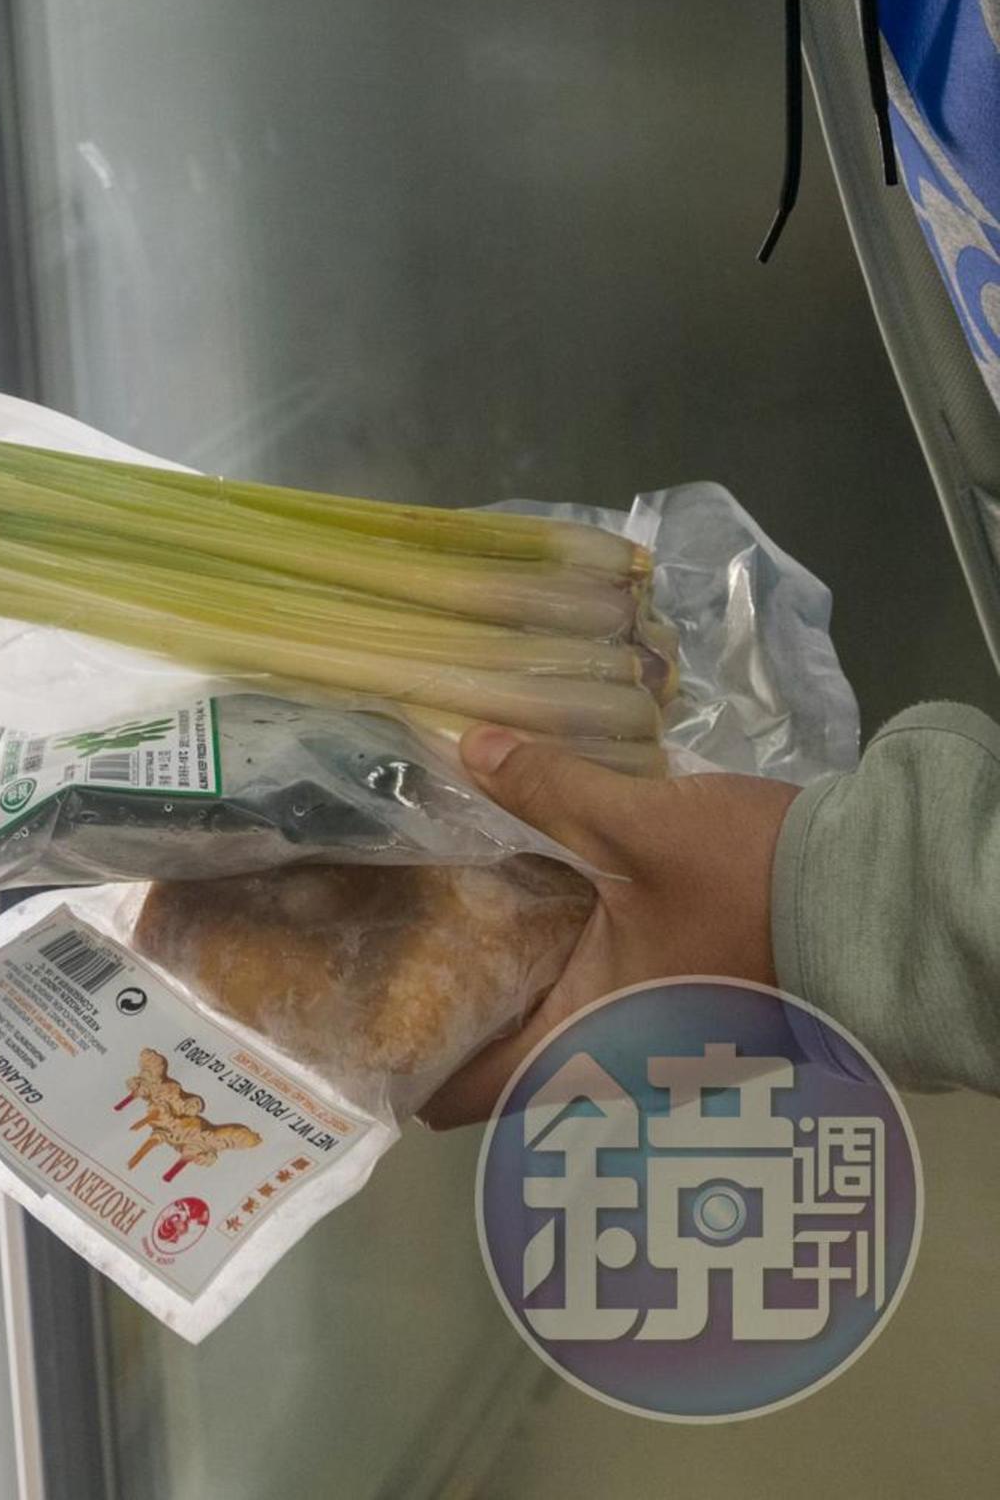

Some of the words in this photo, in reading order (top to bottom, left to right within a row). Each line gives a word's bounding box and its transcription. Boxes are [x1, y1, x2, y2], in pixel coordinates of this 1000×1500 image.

[57, 990, 84, 1016] FROZEN
[81, 1013, 100, 1031] KEEP
[173, 1035, 195, 1057] g)
[186, 1045, 215, 1068] (200
[208, 1057, 225, 1074] oz
[227, 1071, 257, 1097] NET:
[250, 1087, 289, 1118] POIDS
[287, 1115, 315, 1138] WT.
[307, 1128, 339, 1151] NET
[68, 1165, 145, 1235] FROZEN
